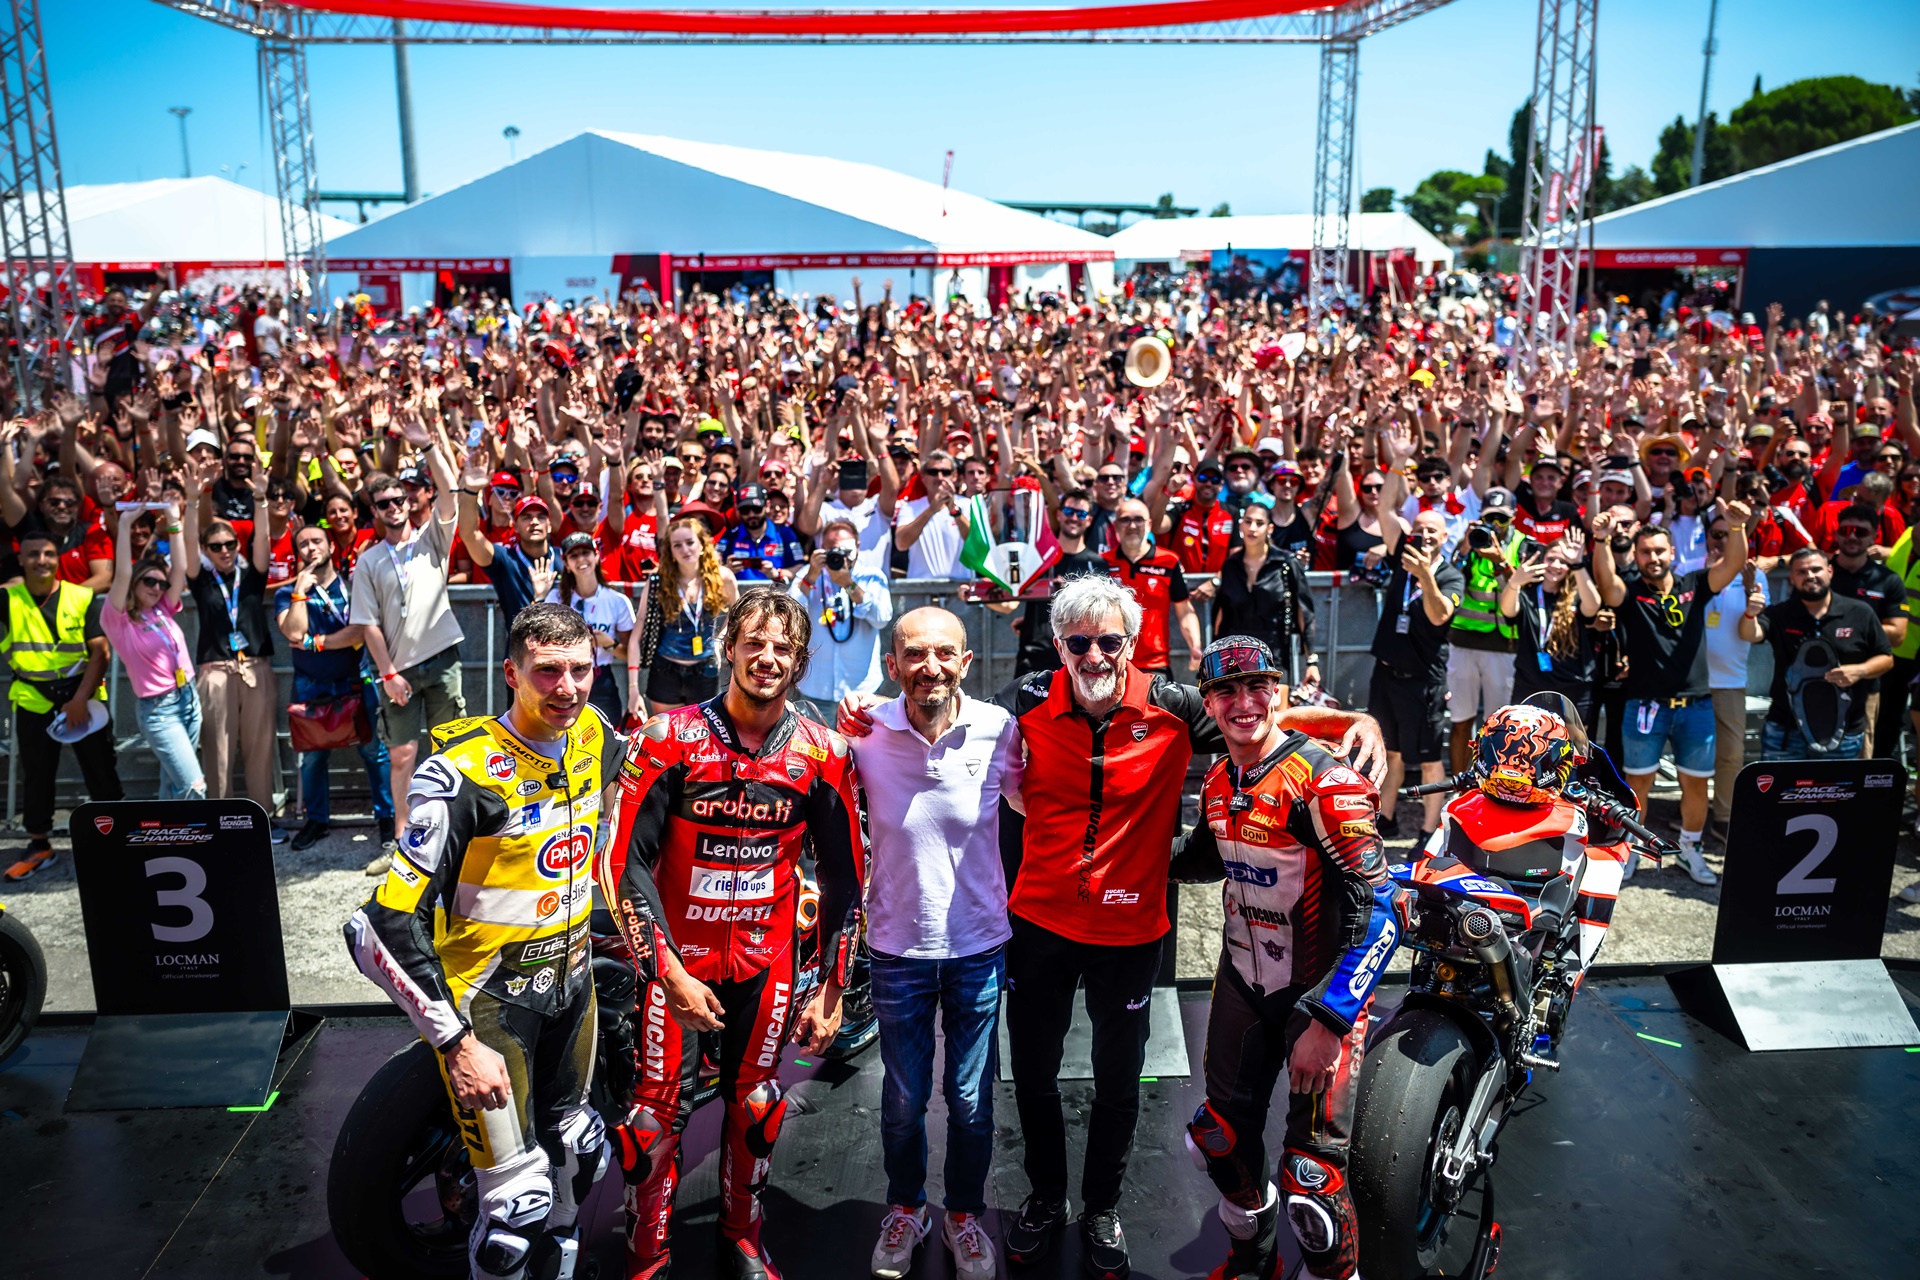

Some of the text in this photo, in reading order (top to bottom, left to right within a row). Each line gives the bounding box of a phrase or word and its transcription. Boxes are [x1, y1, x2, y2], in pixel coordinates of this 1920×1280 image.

[1615, 253, 1650, 263] DUCATI
[703, 707, 732, 744] DUCATI
[502, 738, 552, 769] GIMOTO
[486, 757, 516, 777] NILS
[1782, 792, 1857, 800] CHAMPIONS
[692, 791, 793, 823] aruba.it
[129, 834, 213, 842] CHAMPIONS
[146, 828, 193, 836] RACE
[556, 826, 581, 841] SNACK
[1081, 802, 1103, 861] DUCATI
[1243, 828, 1267, 840] BONI
[550, 839, 585, 865] PATA
[702, 838, 773, 859] Lenovo
[1776, 814, 1839, 895] 2
[714, 874, 766, 893] riello ups
[1077, 860, 1092, 904] CORSE
[144, 856, 214, 943] 3
[685, 904, 774, 922] DUCATI
[1774, 905, 1832, 916] LOCMAN
[621, 898, 653, 959] aruba.it
[155, 953, 220, 966] LOCMAN
[744, 946, 773, 955] SBK
[1353, 929, 1395, 992] epiu
[646, 984, 666, 1082] DUCATI
[757, 982, 790, 1068] DUCATI
